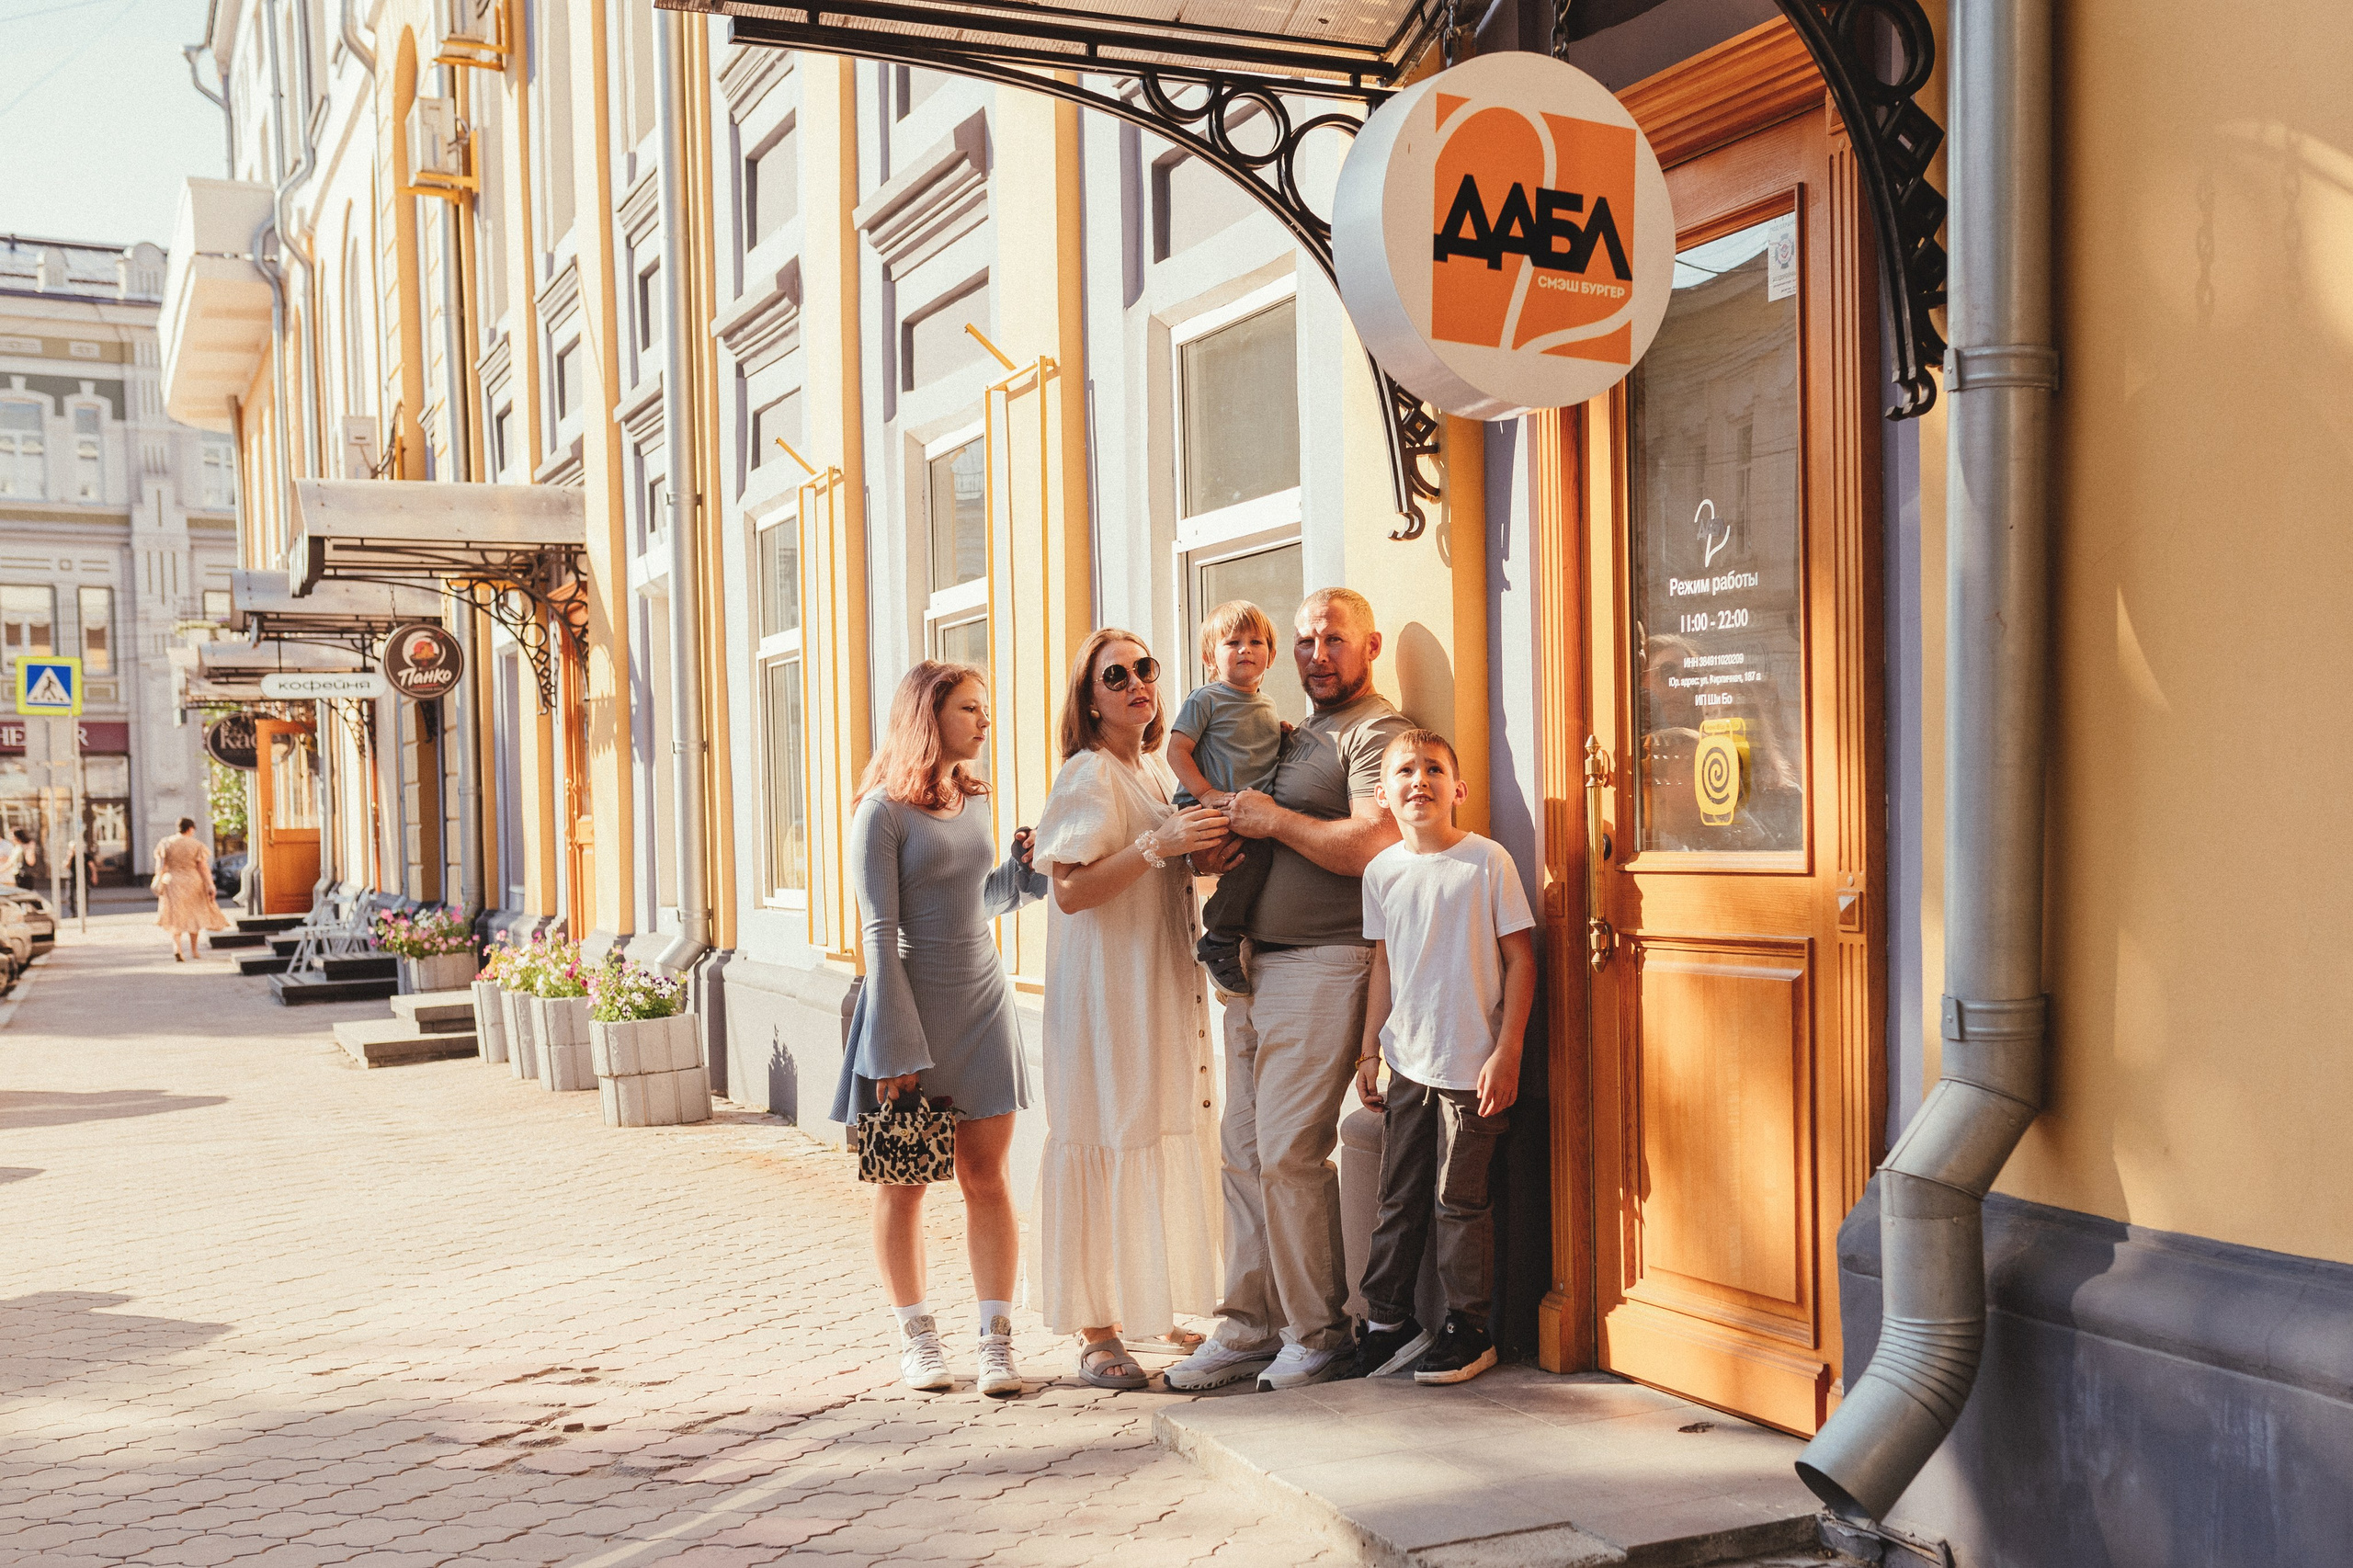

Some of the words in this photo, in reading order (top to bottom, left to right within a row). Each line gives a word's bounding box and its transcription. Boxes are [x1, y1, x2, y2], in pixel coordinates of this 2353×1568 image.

[1433, 174, 1633, 281] ДАБЛ
[1538, 275, 1579, 293] СМЭШ
[1581, 281, 1626, 299] БУРГЕР
[1669, 577, 1711, 597] Режим
[1711, 570, 1758, 597] работы
[1680, 612, 1709, 633] 11:00
[1717, 608, 1749, 630] 22:00
[1683, 656, 1699, 669] ИНН
[278, 679, 370, 692] кофейня
[397, 667, 453, 687] Панко
[1694, 694, 1707, 707] ИП
[1708, 693, 1721, 706] Ши
[1721, 692, 1733, 705] Бо
